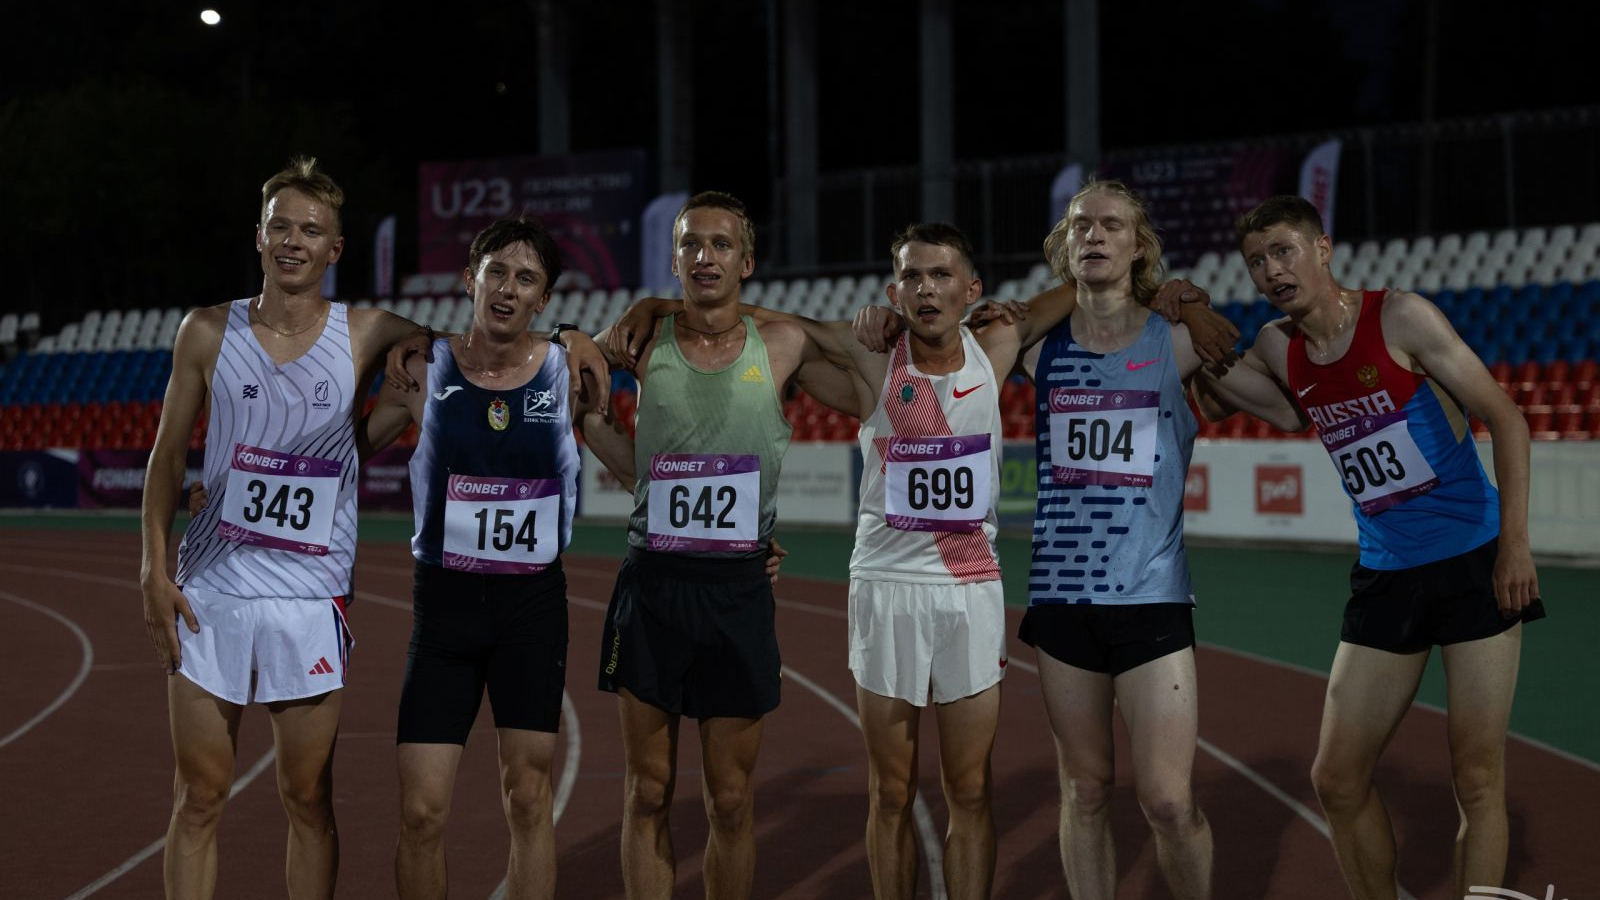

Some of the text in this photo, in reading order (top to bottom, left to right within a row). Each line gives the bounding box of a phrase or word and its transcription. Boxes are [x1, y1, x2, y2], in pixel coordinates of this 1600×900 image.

[431, 177, 513, 218] U23
[1054, 394, 1103, 406] FONBET
[1307, 389, 1396, 431] RUSSIA
[891, 443, 943, 455] FONBET
[1068, 418, 1134, 462] 504
[93, 468, 147, 490] FONBE
[237, 452, 288, 470] FONBET
[655, 461, 706, 472] FONBET
[1339, 440, 1406, 495] 503
[243, 479, 314, 531] 343
[455, 481, 508, 495] FONBET
[669, 485, 737, 529] 642
[908, 466, 974, 511] 699
[474, 508, 538, 552] 154
